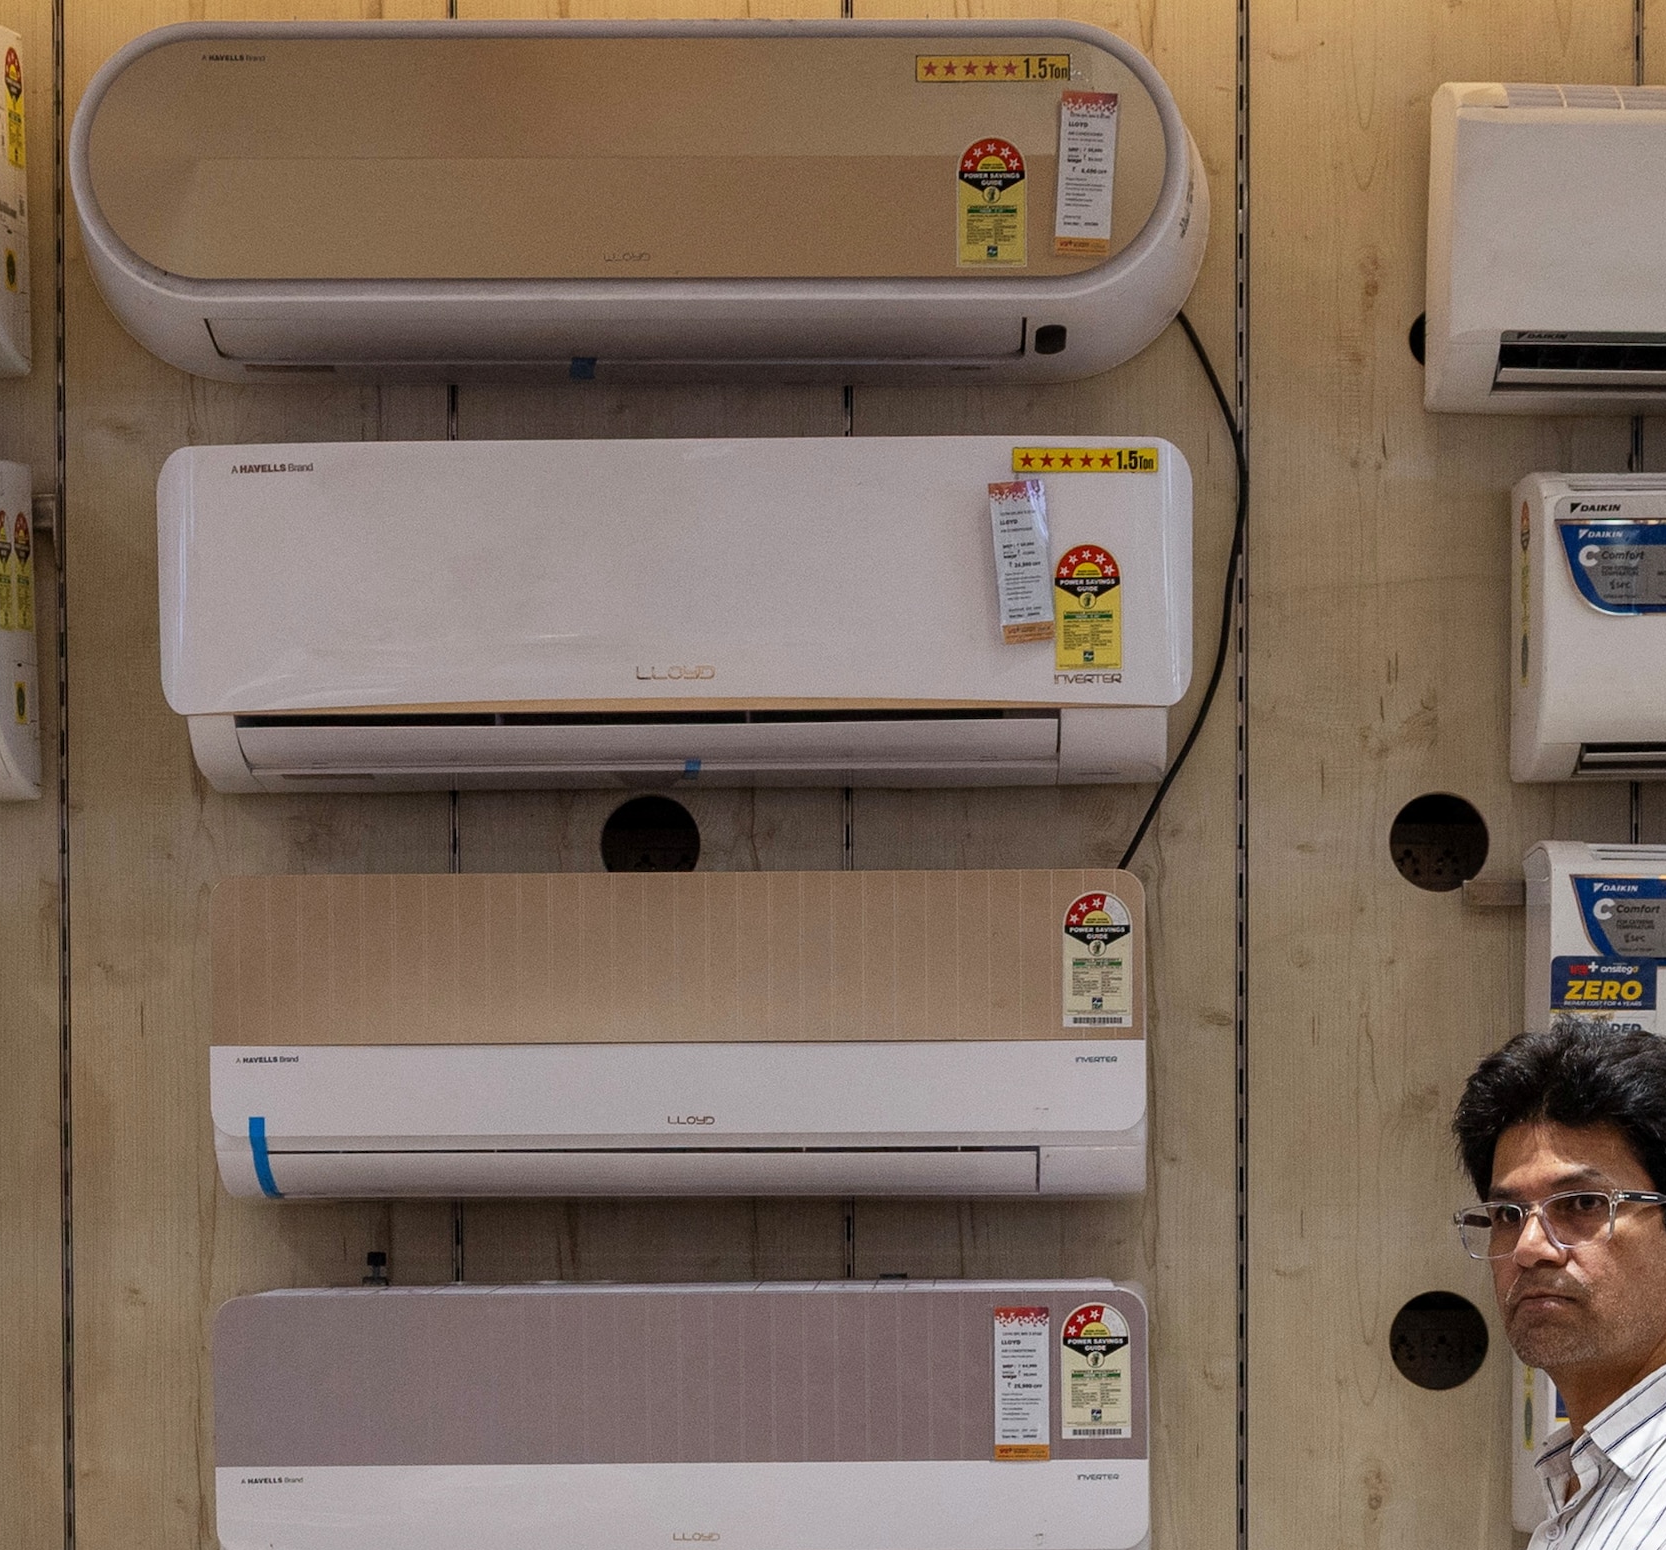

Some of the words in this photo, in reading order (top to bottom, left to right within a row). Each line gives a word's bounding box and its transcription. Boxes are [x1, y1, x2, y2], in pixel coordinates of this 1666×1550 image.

[1023, 58, 1048, 79] 1.5
[1049, 64, 1068, 79] Ton
[1116, 451, 1138, 469] 1.5
[1139, 456, 1154, 469] Ton
[231, 465, 238, 474] A
[240, 464, 286, 473] HAVELLS
[288, 463, 313, 472] Brand
[1581, 503, 1621, 513] DAIKIN
[636, 666, 715, 679] LLOYD
[1054, 673, 1122, 685] INVERTER
[667, 1115, 715, 1125] LLOYD
